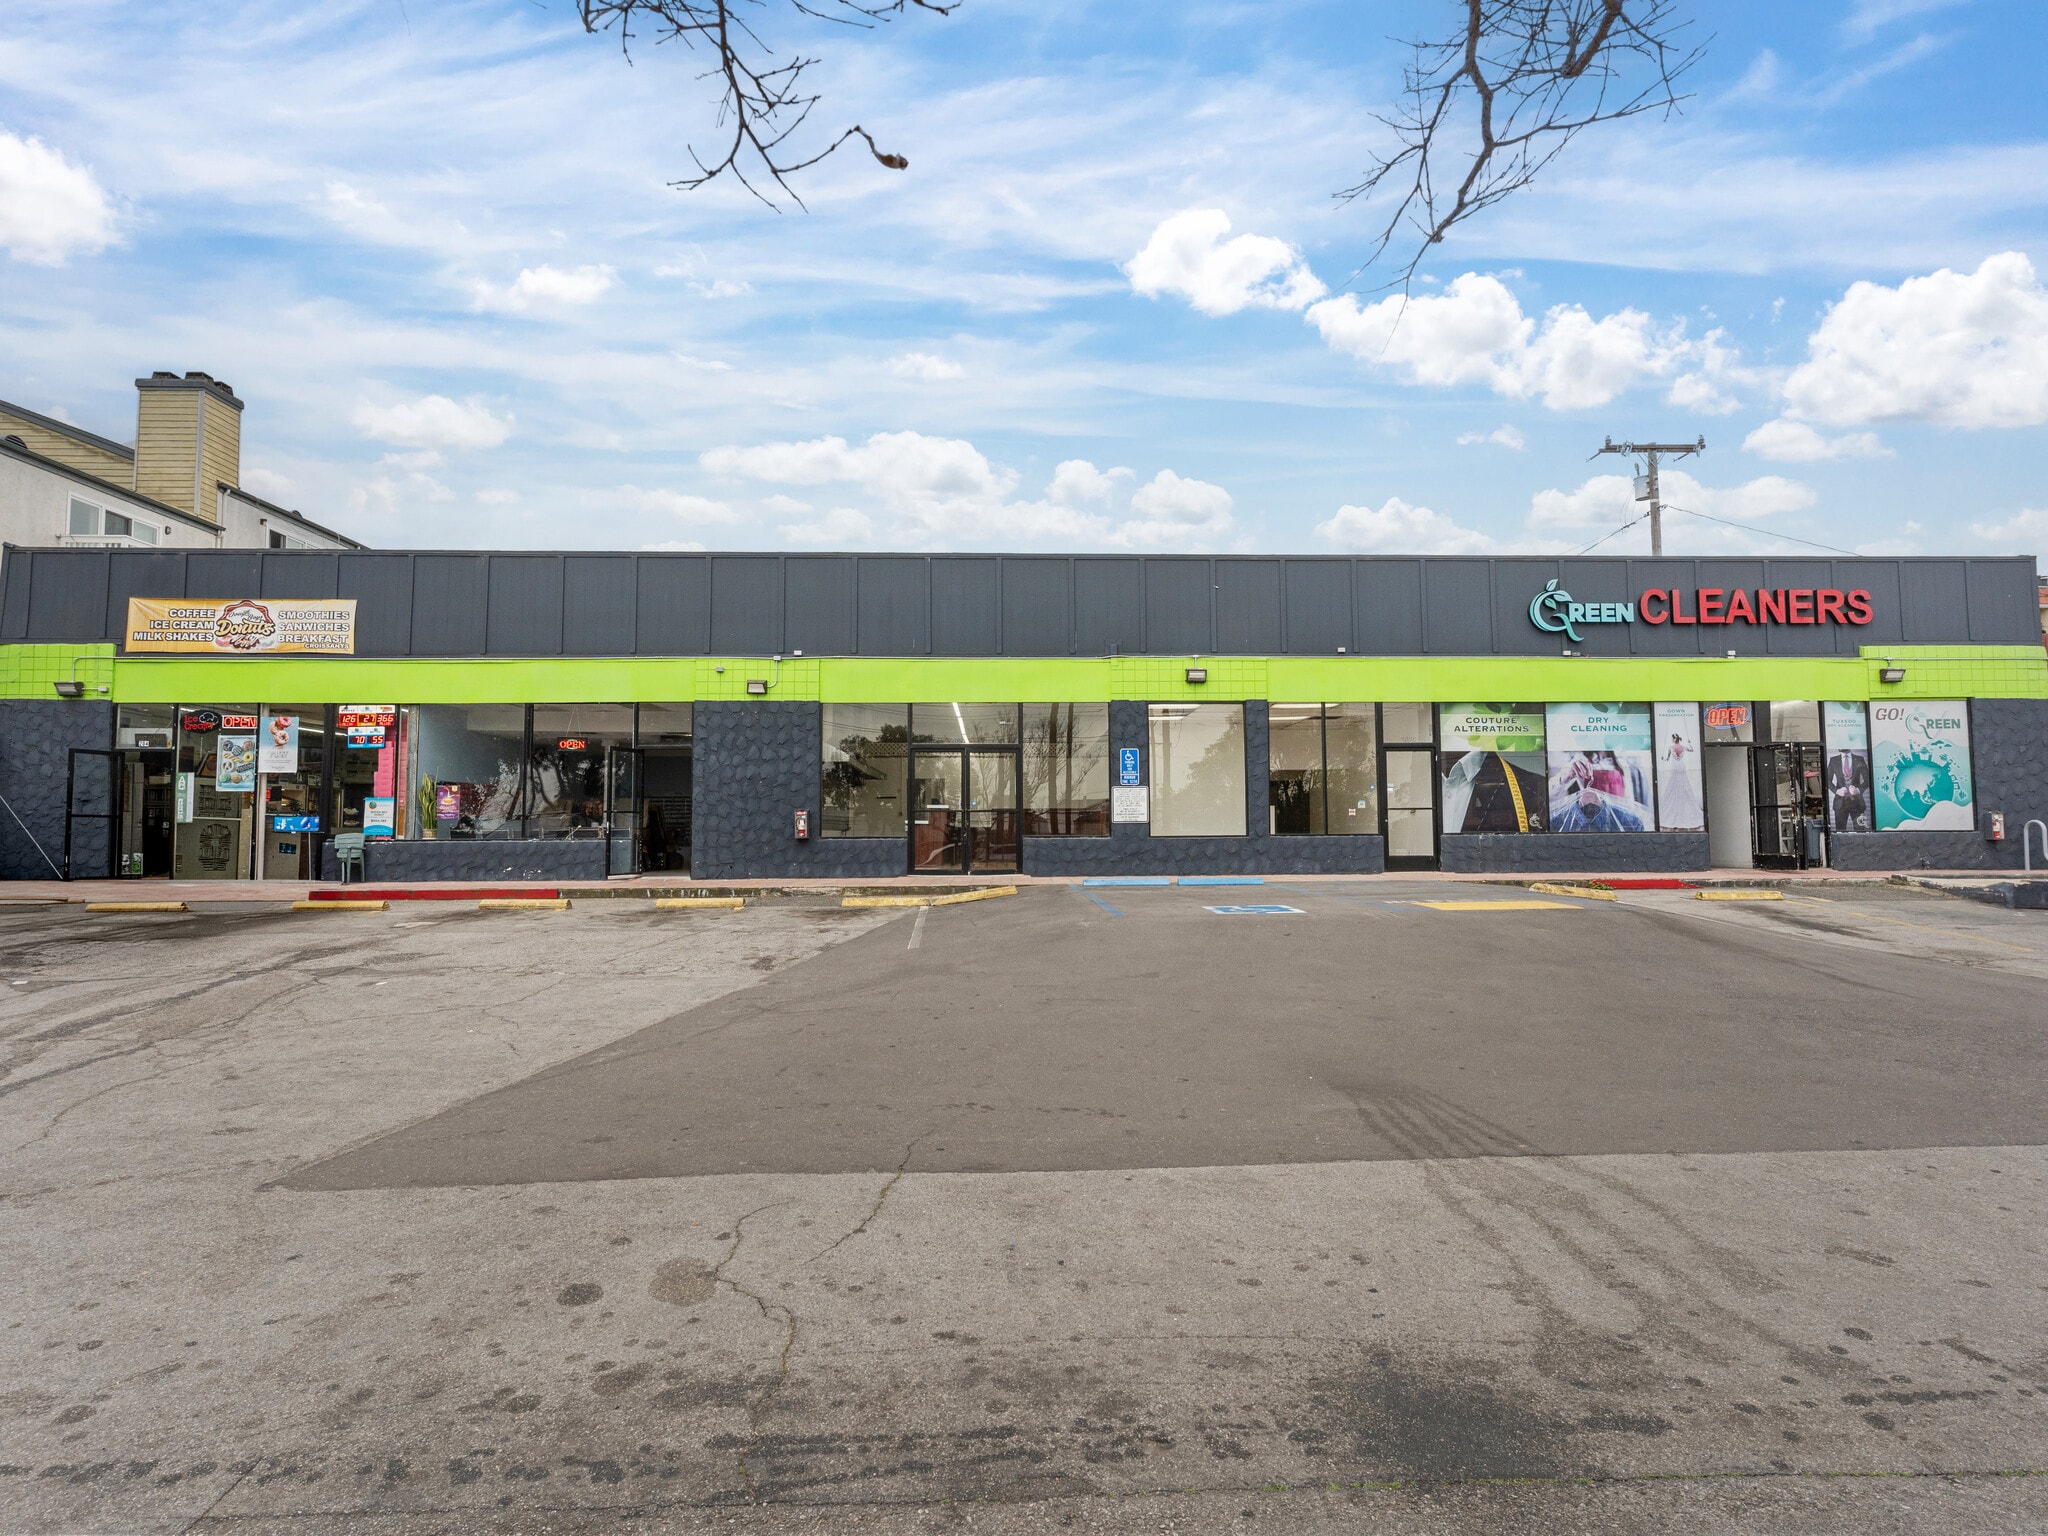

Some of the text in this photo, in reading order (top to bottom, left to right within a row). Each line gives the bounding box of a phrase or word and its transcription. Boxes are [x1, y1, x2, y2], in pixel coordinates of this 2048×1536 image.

[169, 608, 215, 618] COFFEE
[278, 610, 350, 620] SMOOTHIES
[1529, 579, 1874, 641] GREEN CLEANERS
[150, 620, 214, 630] ICE CREAM
[214, 618, 276, 637] Donuts
[278, 622, 350, 632] SANWICHES
[133, 631, 214, 642] MILK SHAKES
[277, 634, 349, 643] BREAKFAST
[184, 714, 198, 723] Ice
[342, 714, 394, 723] 126 27 366
[1707, 707, 1747, 727] OPEN
[1875, 707, 1905, 721] GO!
[223, 716, 257, 728] OPEN
[1588, 716, 1609, 724] DRY
[355, 735, 384, 744] 70 55
[559, 739, 585, 749] OPEN
